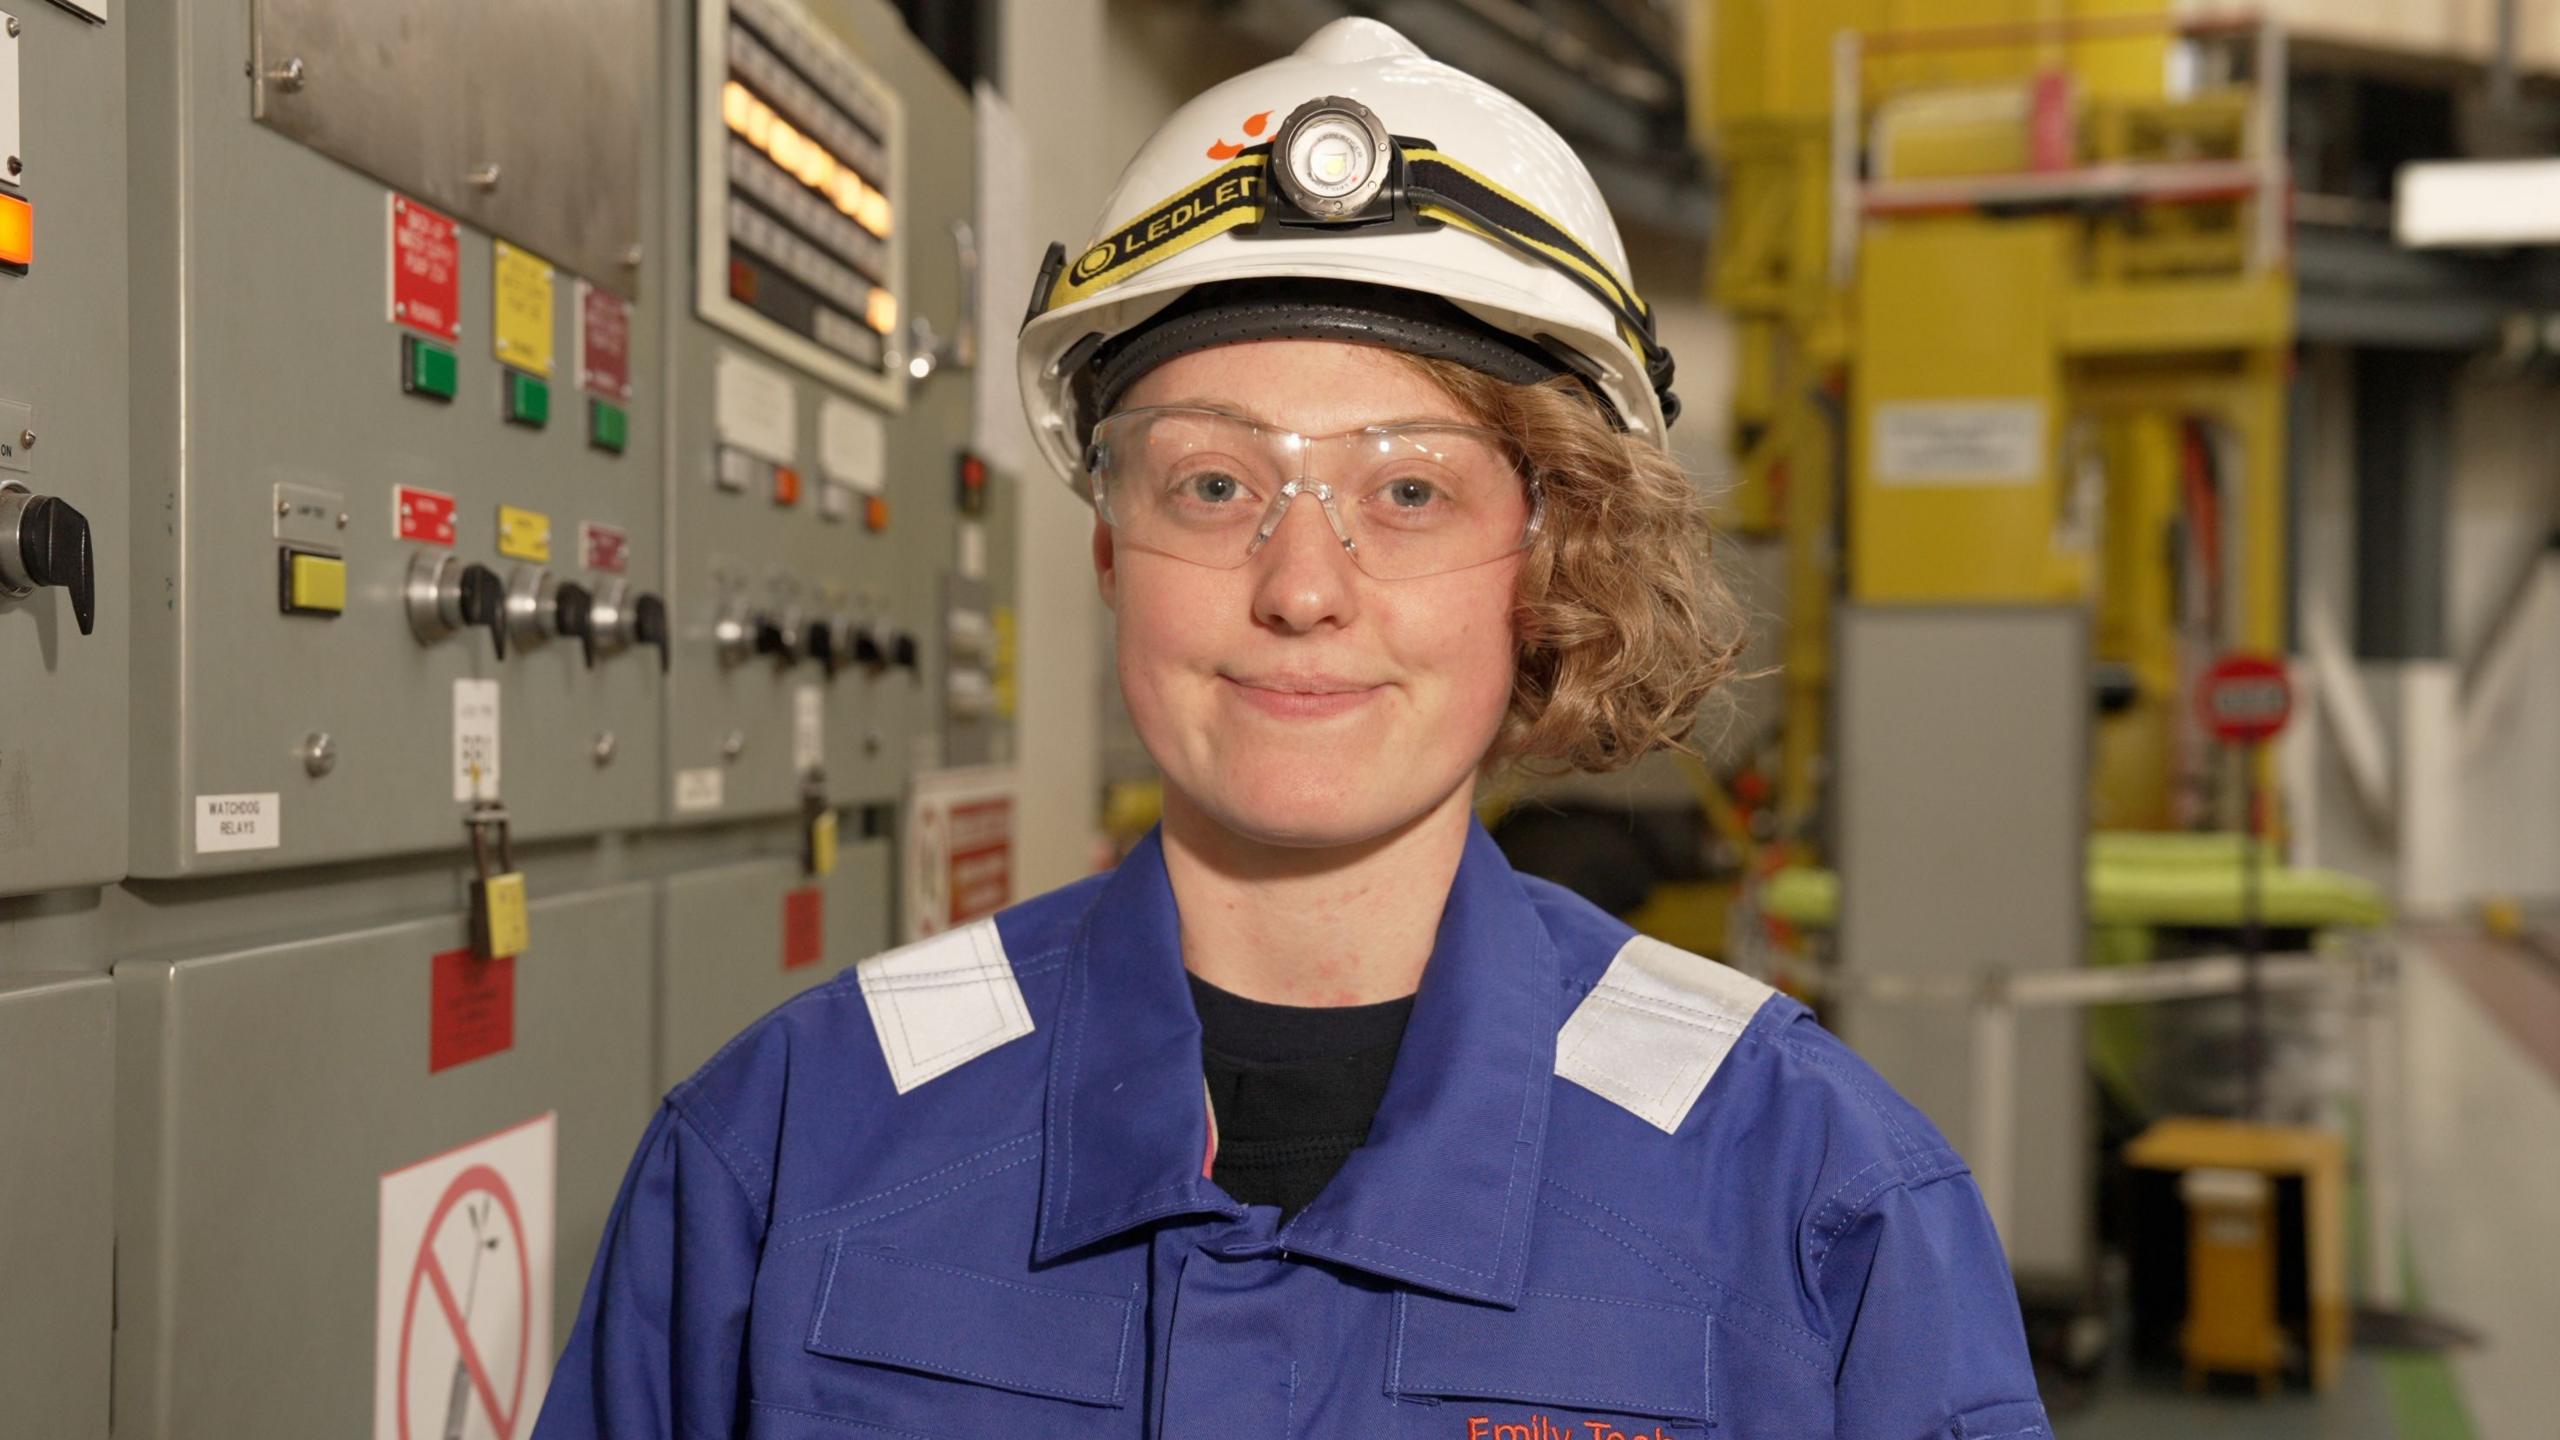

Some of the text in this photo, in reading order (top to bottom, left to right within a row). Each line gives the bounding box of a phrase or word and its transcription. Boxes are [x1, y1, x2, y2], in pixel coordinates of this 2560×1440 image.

[1, 443, 12, 457] ON
[208, 801, 260, 815] WATCHDOG
[220, 821, 255, 835] RELAYS
